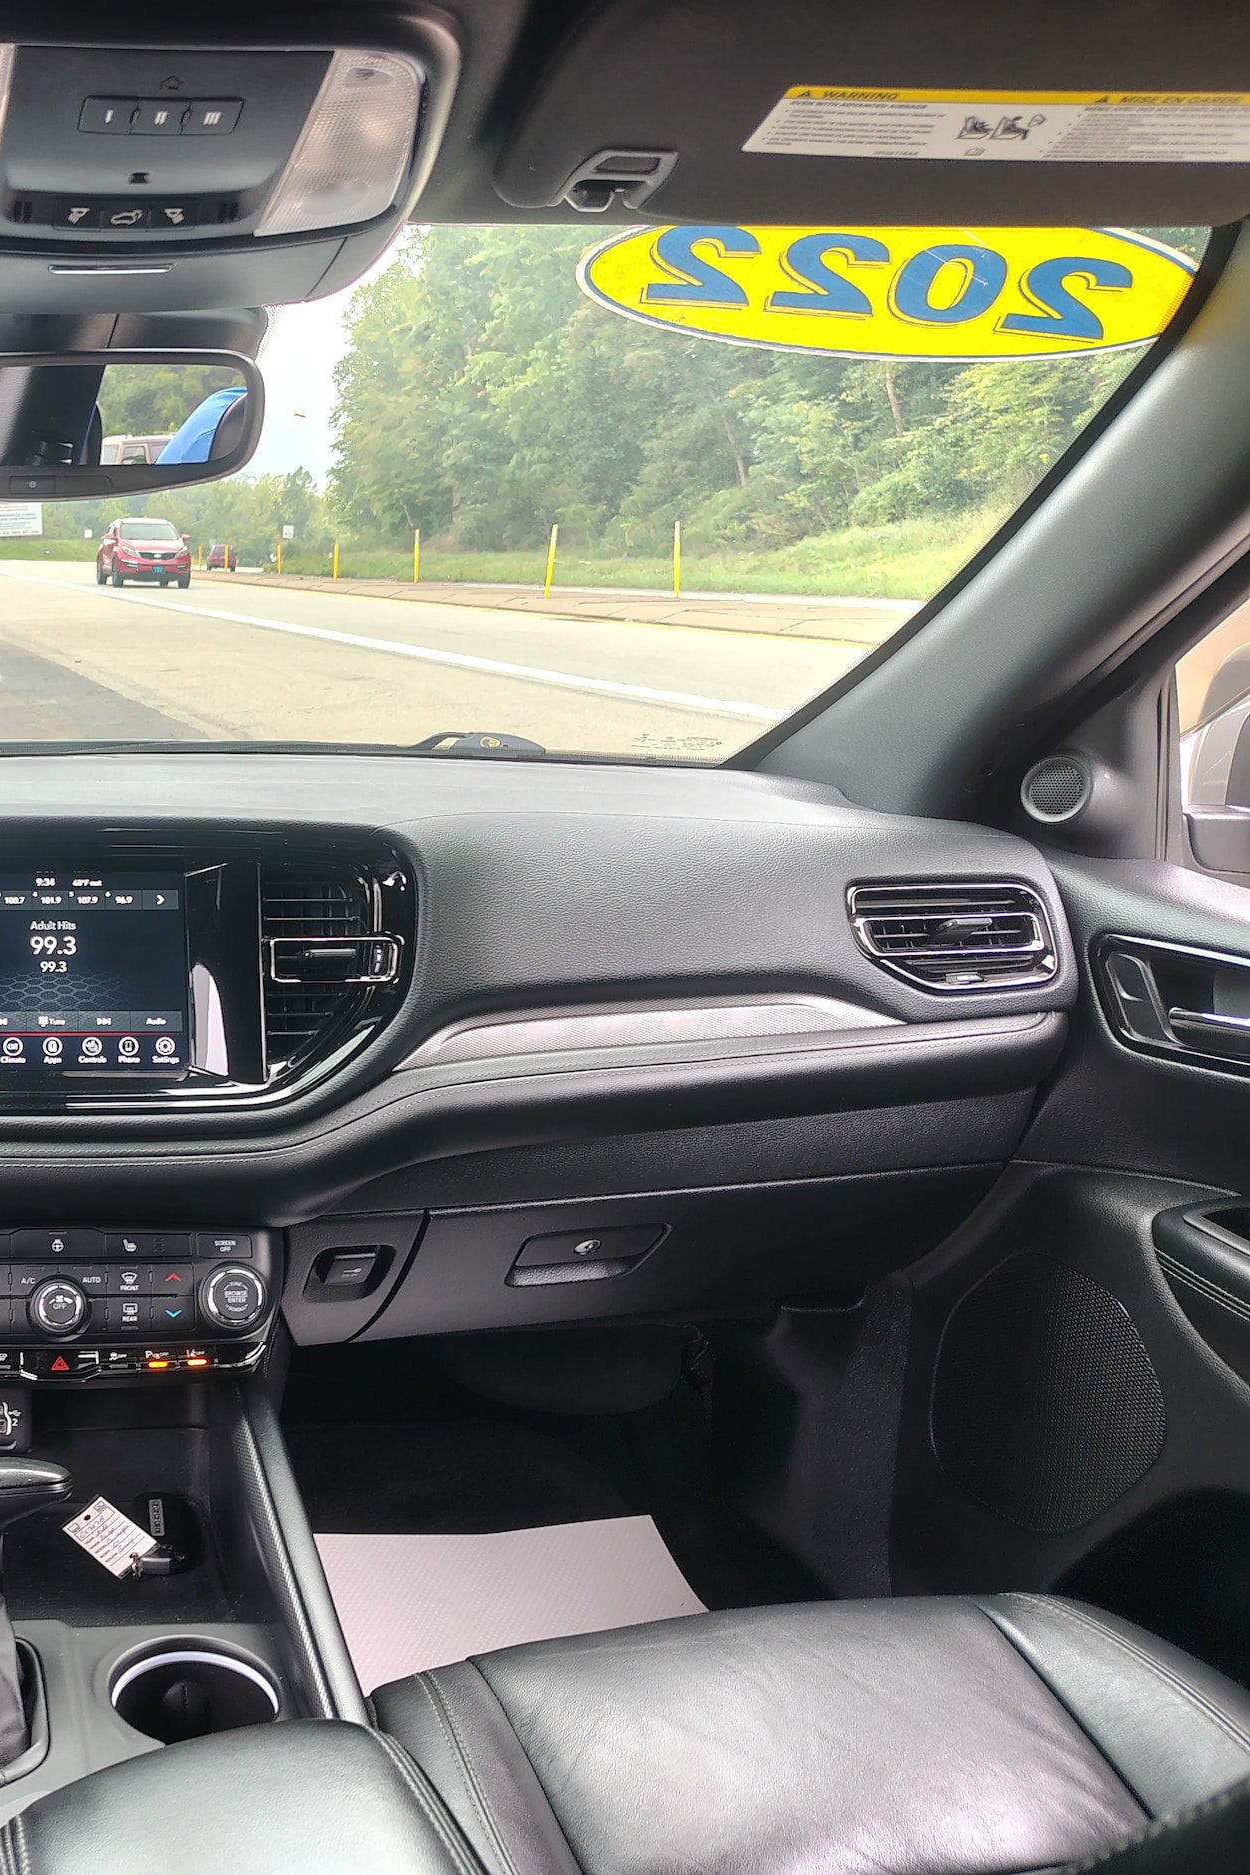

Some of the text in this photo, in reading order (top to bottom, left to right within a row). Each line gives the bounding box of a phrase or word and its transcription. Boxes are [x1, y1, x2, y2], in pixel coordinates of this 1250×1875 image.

[822, 90, 899, 101] WARNING
[30, 920, 77, 931] Adult Hits
[30, 935, 77, 956] 99.3
[39, 961, 68, 972] 99.3
[145, 1017, 167, 1025] Audio
[0, 1056, 27, 1064] Climate
[43, 1056, 63, 1065] Apps
[78, 1055, 108, 1064] Controls
[117, 1055, 141, 1063] Phone
[152, 1055, 180, 1064] Settings
[21, 1277, 37, 1285] A/C
[82, 1275, 102, 1284] AUTO
[11, 1418, 18, 1427] 2
